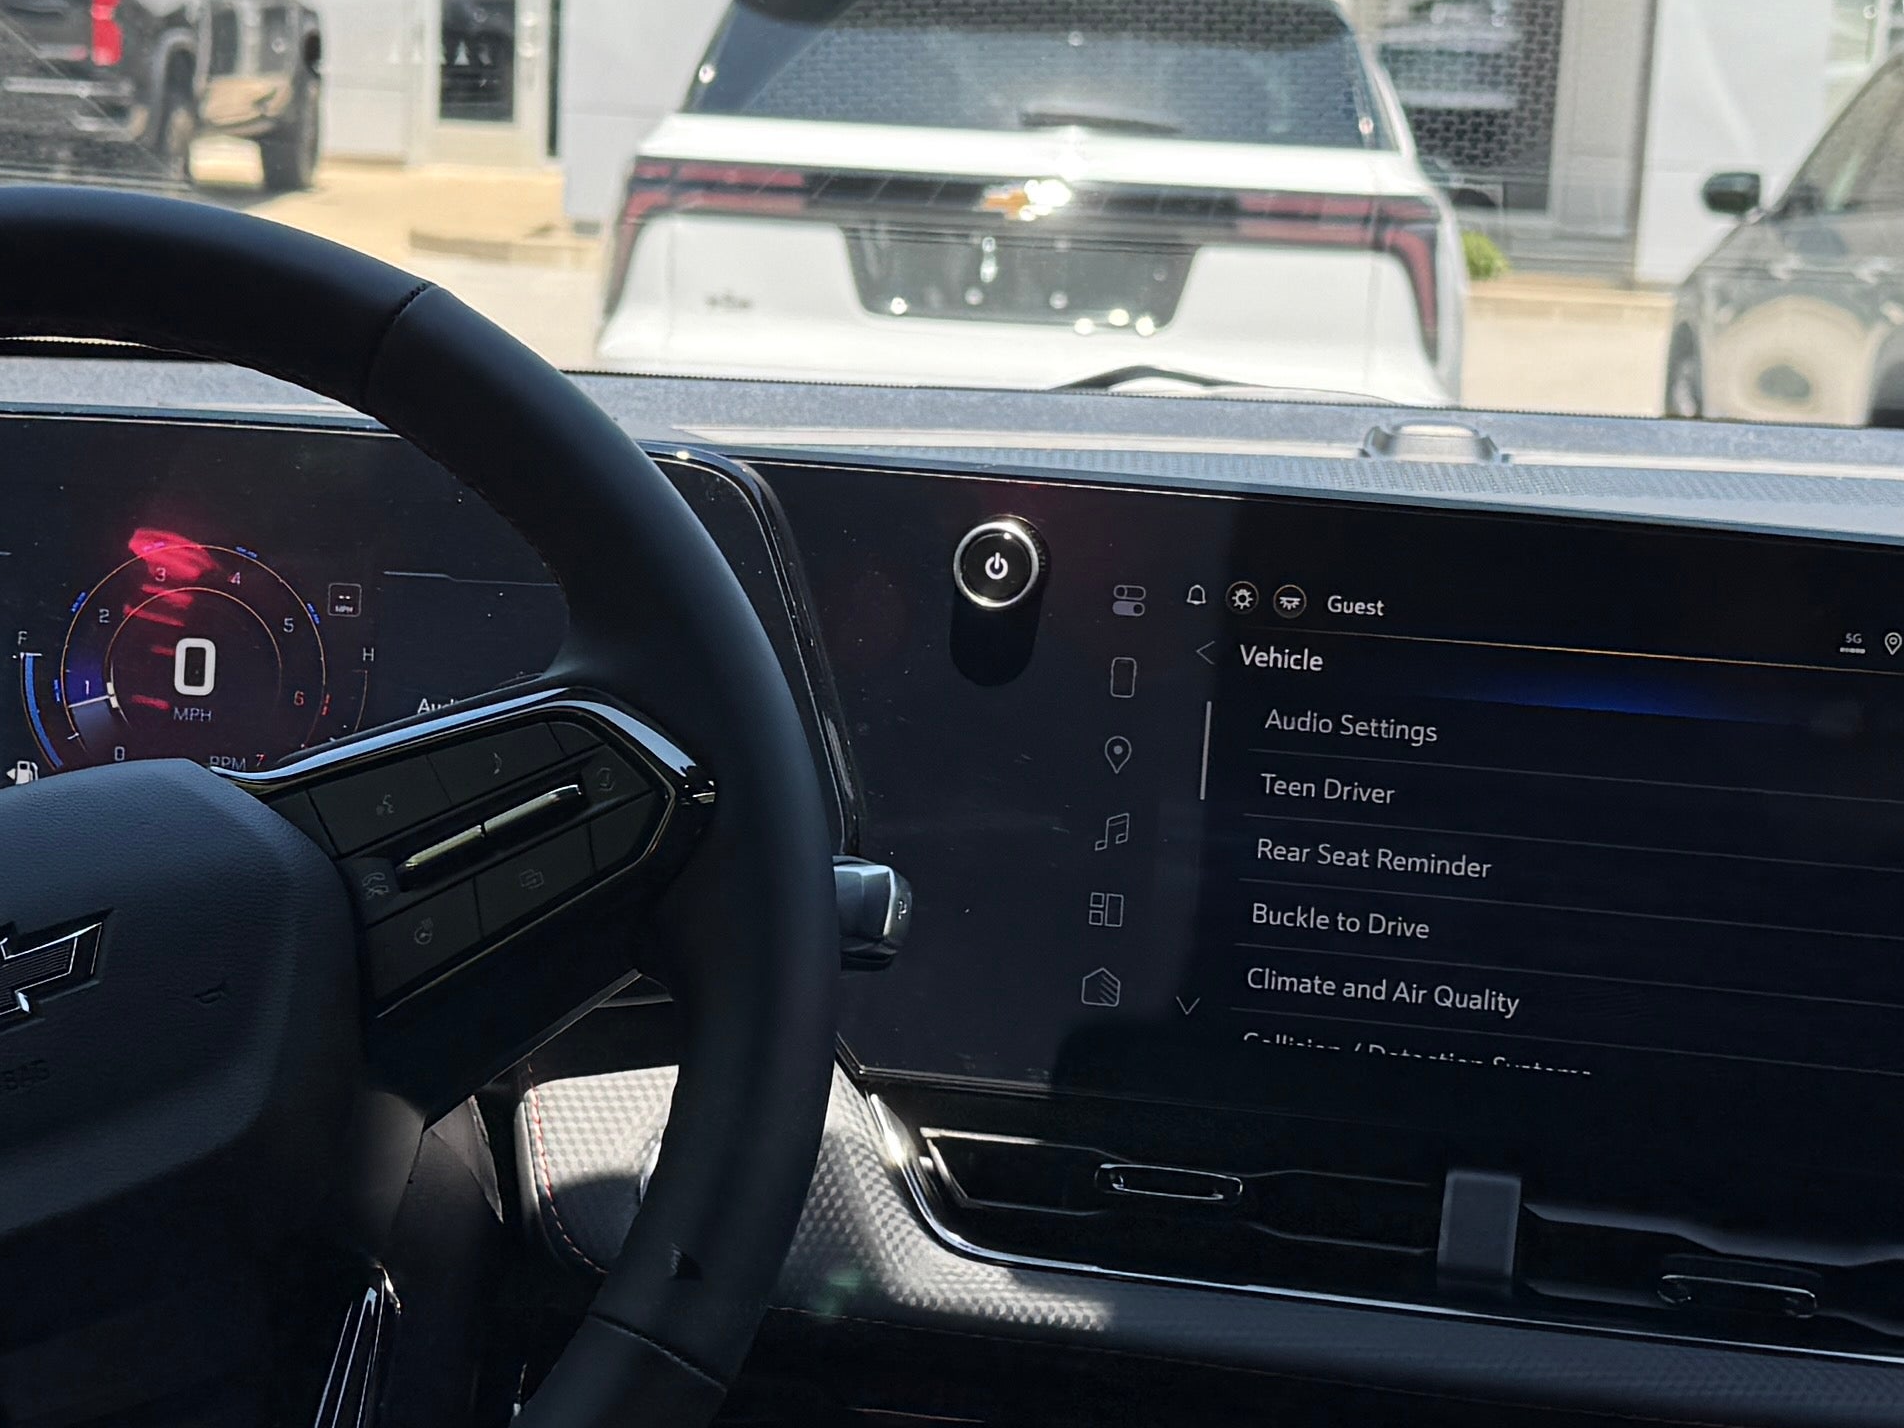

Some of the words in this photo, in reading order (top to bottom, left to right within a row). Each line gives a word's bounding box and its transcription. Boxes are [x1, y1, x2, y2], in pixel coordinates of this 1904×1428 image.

[156, 568, 167, 581] 3
[230, 572, 241, 585] 4
[1327, 595, 1385, 616] Guest
[99, 609, 111, 624] 2
[284, 618, 294, 633] 5
[17, 631, 28, 645] F
[1846, 633, 1862, 644] 5G
[362, 648, 375, 661] H
[1240, 644, 1323, 671] Vehicle
[174, 638, 216, 696] 0
[85, 680, 91, 695] 1
[294, 691, 304, 706] 6
[173, 707, 212, 723] MPH
[1265, 709, 1333, 733] Audio
[1340, 714, 1438, 746] Settings
[114, 746, 125, 761] 0
[1261, 773, 1316, 798] Teen
[1324, 779, 1395, 804] Driver
[1257, 838, 1310, 863] Rear
[1317, 843, 1370, 869] Seat
[1377, 849, 1492, 879] Reminder
[1252, 903, 1329, 930] Buckle
[1337, 912, 1360, 932] to
[1368, 913, 1430, 939] Drive
[1247, 967, 1336, 996] Climate
[1342, 979, 1386, 1001] and
[1393, 982, 1426, 1005] Air
[1434, 986, 1519, 1019] Quality
